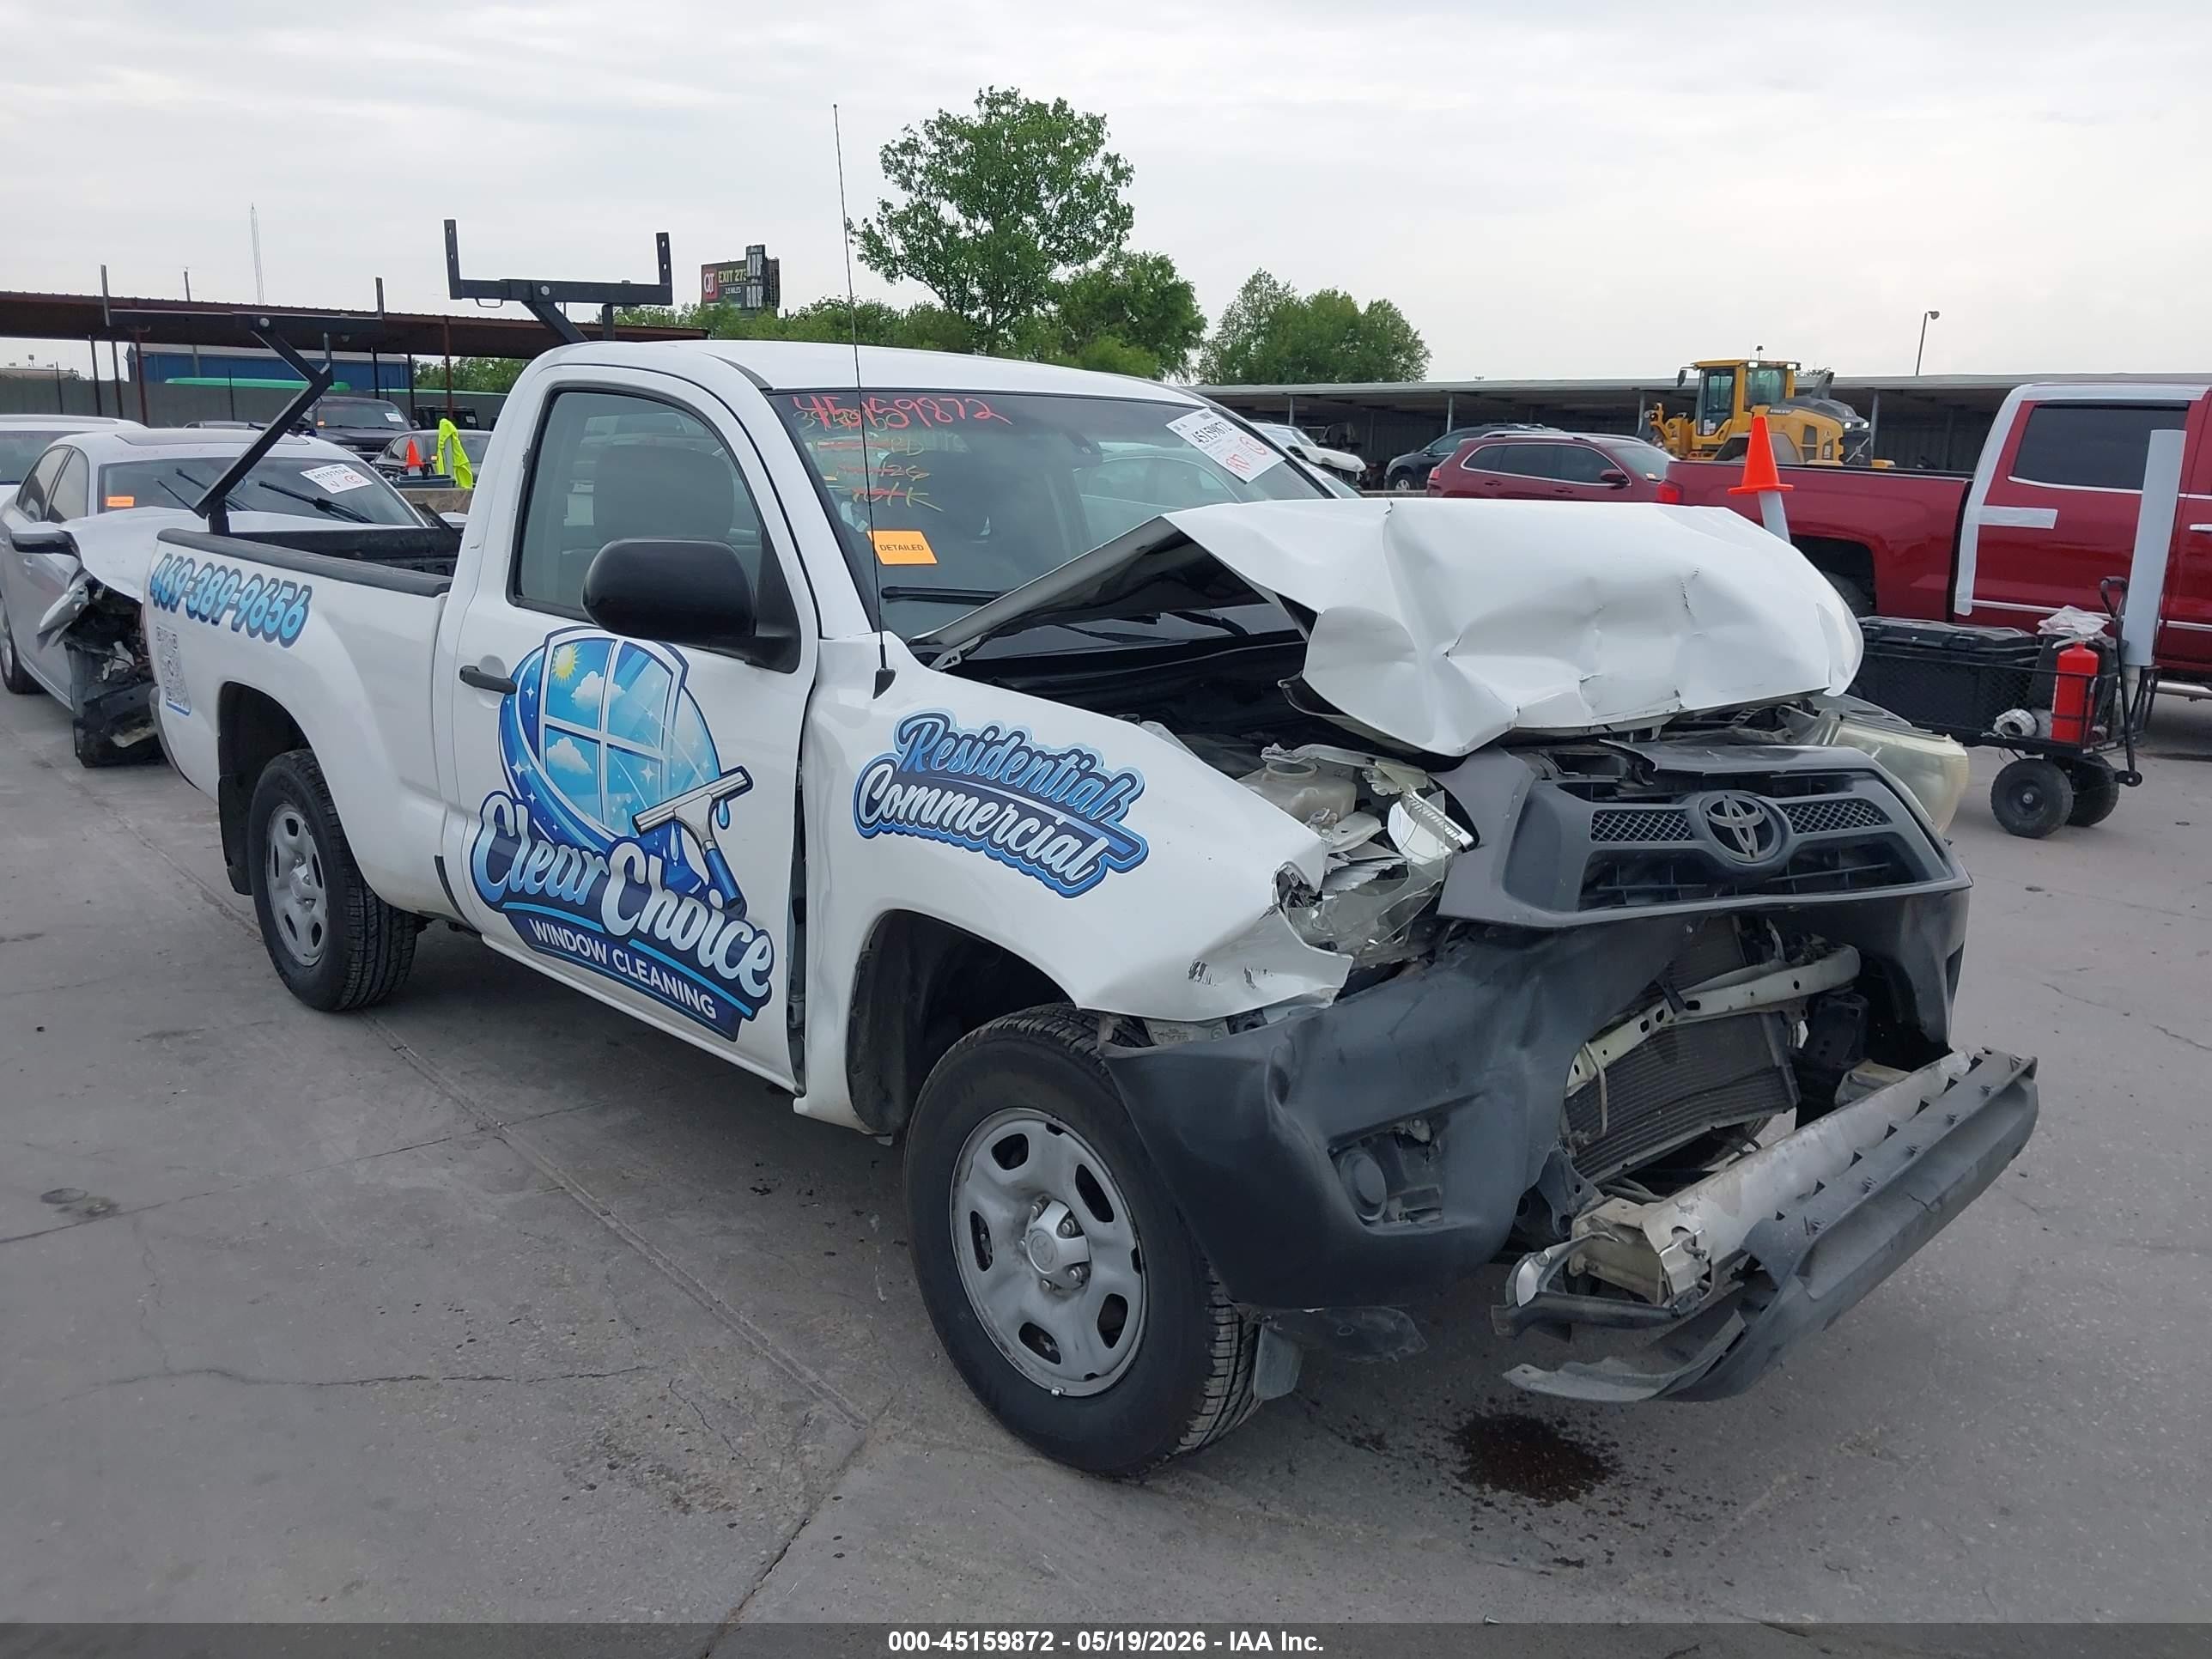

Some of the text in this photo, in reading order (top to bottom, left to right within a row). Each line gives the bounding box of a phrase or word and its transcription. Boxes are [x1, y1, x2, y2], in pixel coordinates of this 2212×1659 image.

[704, 273, 714, 294] QT
[718, 270, 733, 283] EXIT
[793, 397, 1014, 428] 45159872
[1191, 421, 1233, 444] 45159872
[879, 544, 925, 552] DETAILED
[150, 554, 313, 647] 469-389-9656
[898, 714, 1132, 820] Residential
[859, 763, 1109, 882] Commercial
[473, 797, 772, 997] Clear Choice
[529, 918, 717, 1019] WINDOW CLEANING
